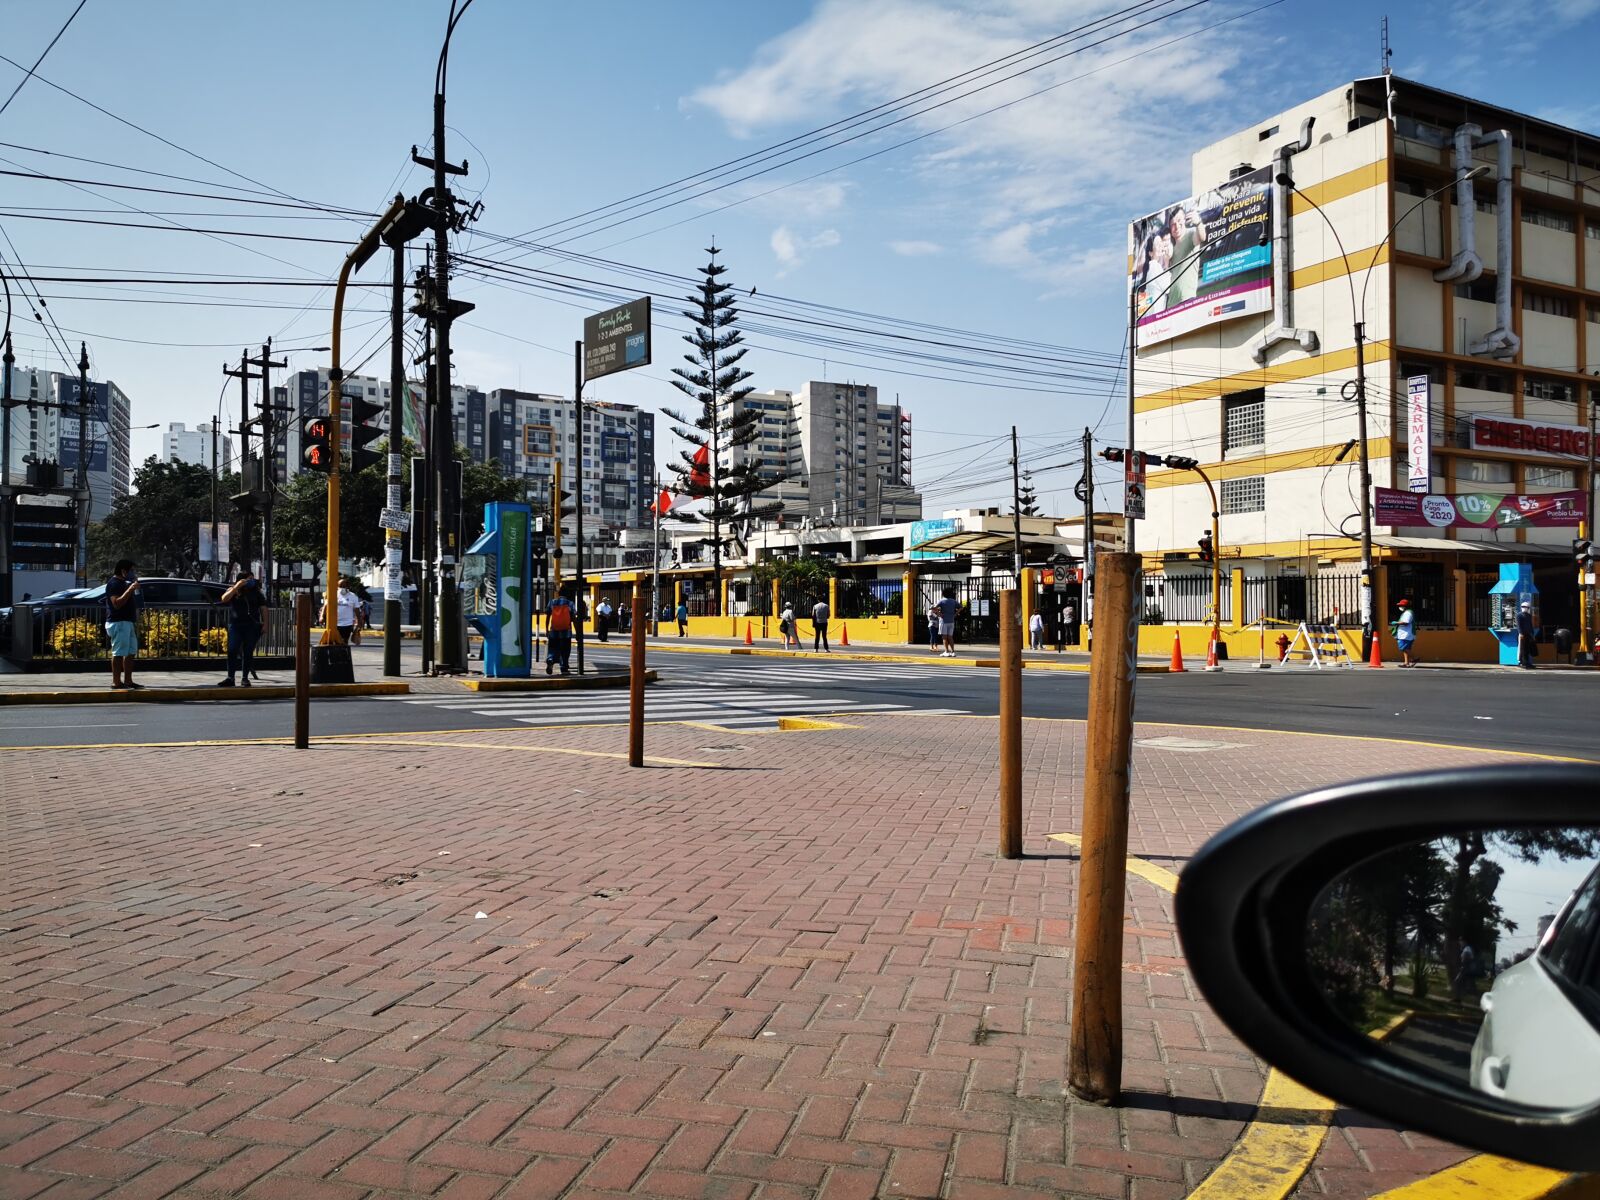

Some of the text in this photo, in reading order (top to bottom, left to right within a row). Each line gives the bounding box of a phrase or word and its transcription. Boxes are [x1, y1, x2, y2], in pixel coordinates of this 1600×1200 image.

[1223, 191, 1265, 217] prevenir,
[1209, 204, 1260, 229] toda una vida
[1208, 212, 1269, 242] para disfrutar.
[616, 309, 631, 323] Park
[609, 323, 633, 337] AMBIENTES
[312, 424, 324, 437] 14
[1412, 394, 1424, 476] FARMACIA
[1456, 495, 1491, 512] 10%
[1518, 496, 1539, 510] 5%
[1430, 511, 1453, 520] 2020
[1500, 509, 1522, 523] 7%
[509, 526, 517, 570] movistar
